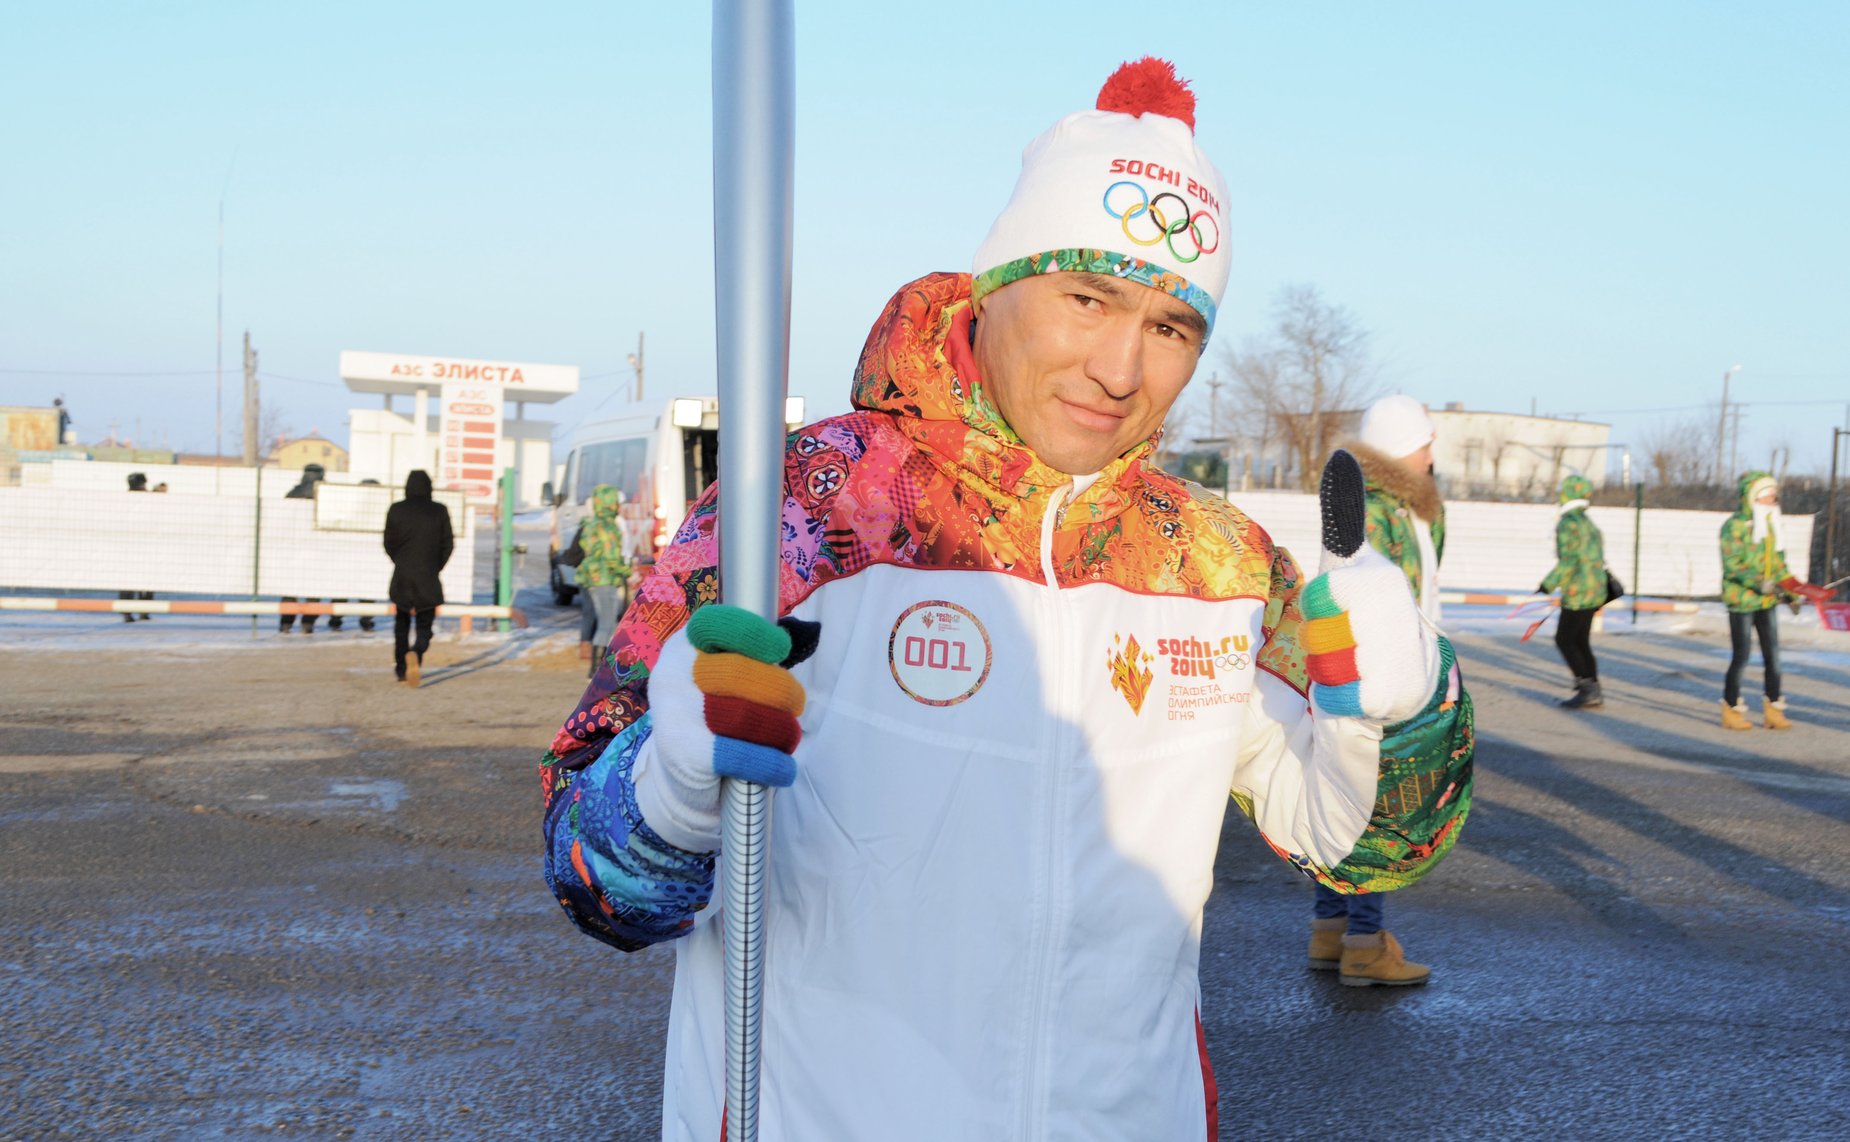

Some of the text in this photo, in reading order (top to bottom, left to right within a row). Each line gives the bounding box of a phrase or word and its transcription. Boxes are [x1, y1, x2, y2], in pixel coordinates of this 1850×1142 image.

[1109, 158, 1220, 216] SOCHI 2014
[391, 362, 524, 384] АЗС ЭЛИСТА
[904, 635, 972, 672] 001
[1157, 635, 1249, 658] sochi.ru
[1170, 657, 1216, 680] 2014
[1168, 684, 1221, 697] ЭСТАФЕТА
[1168, 710, 1195, 721] ОГНЯ
